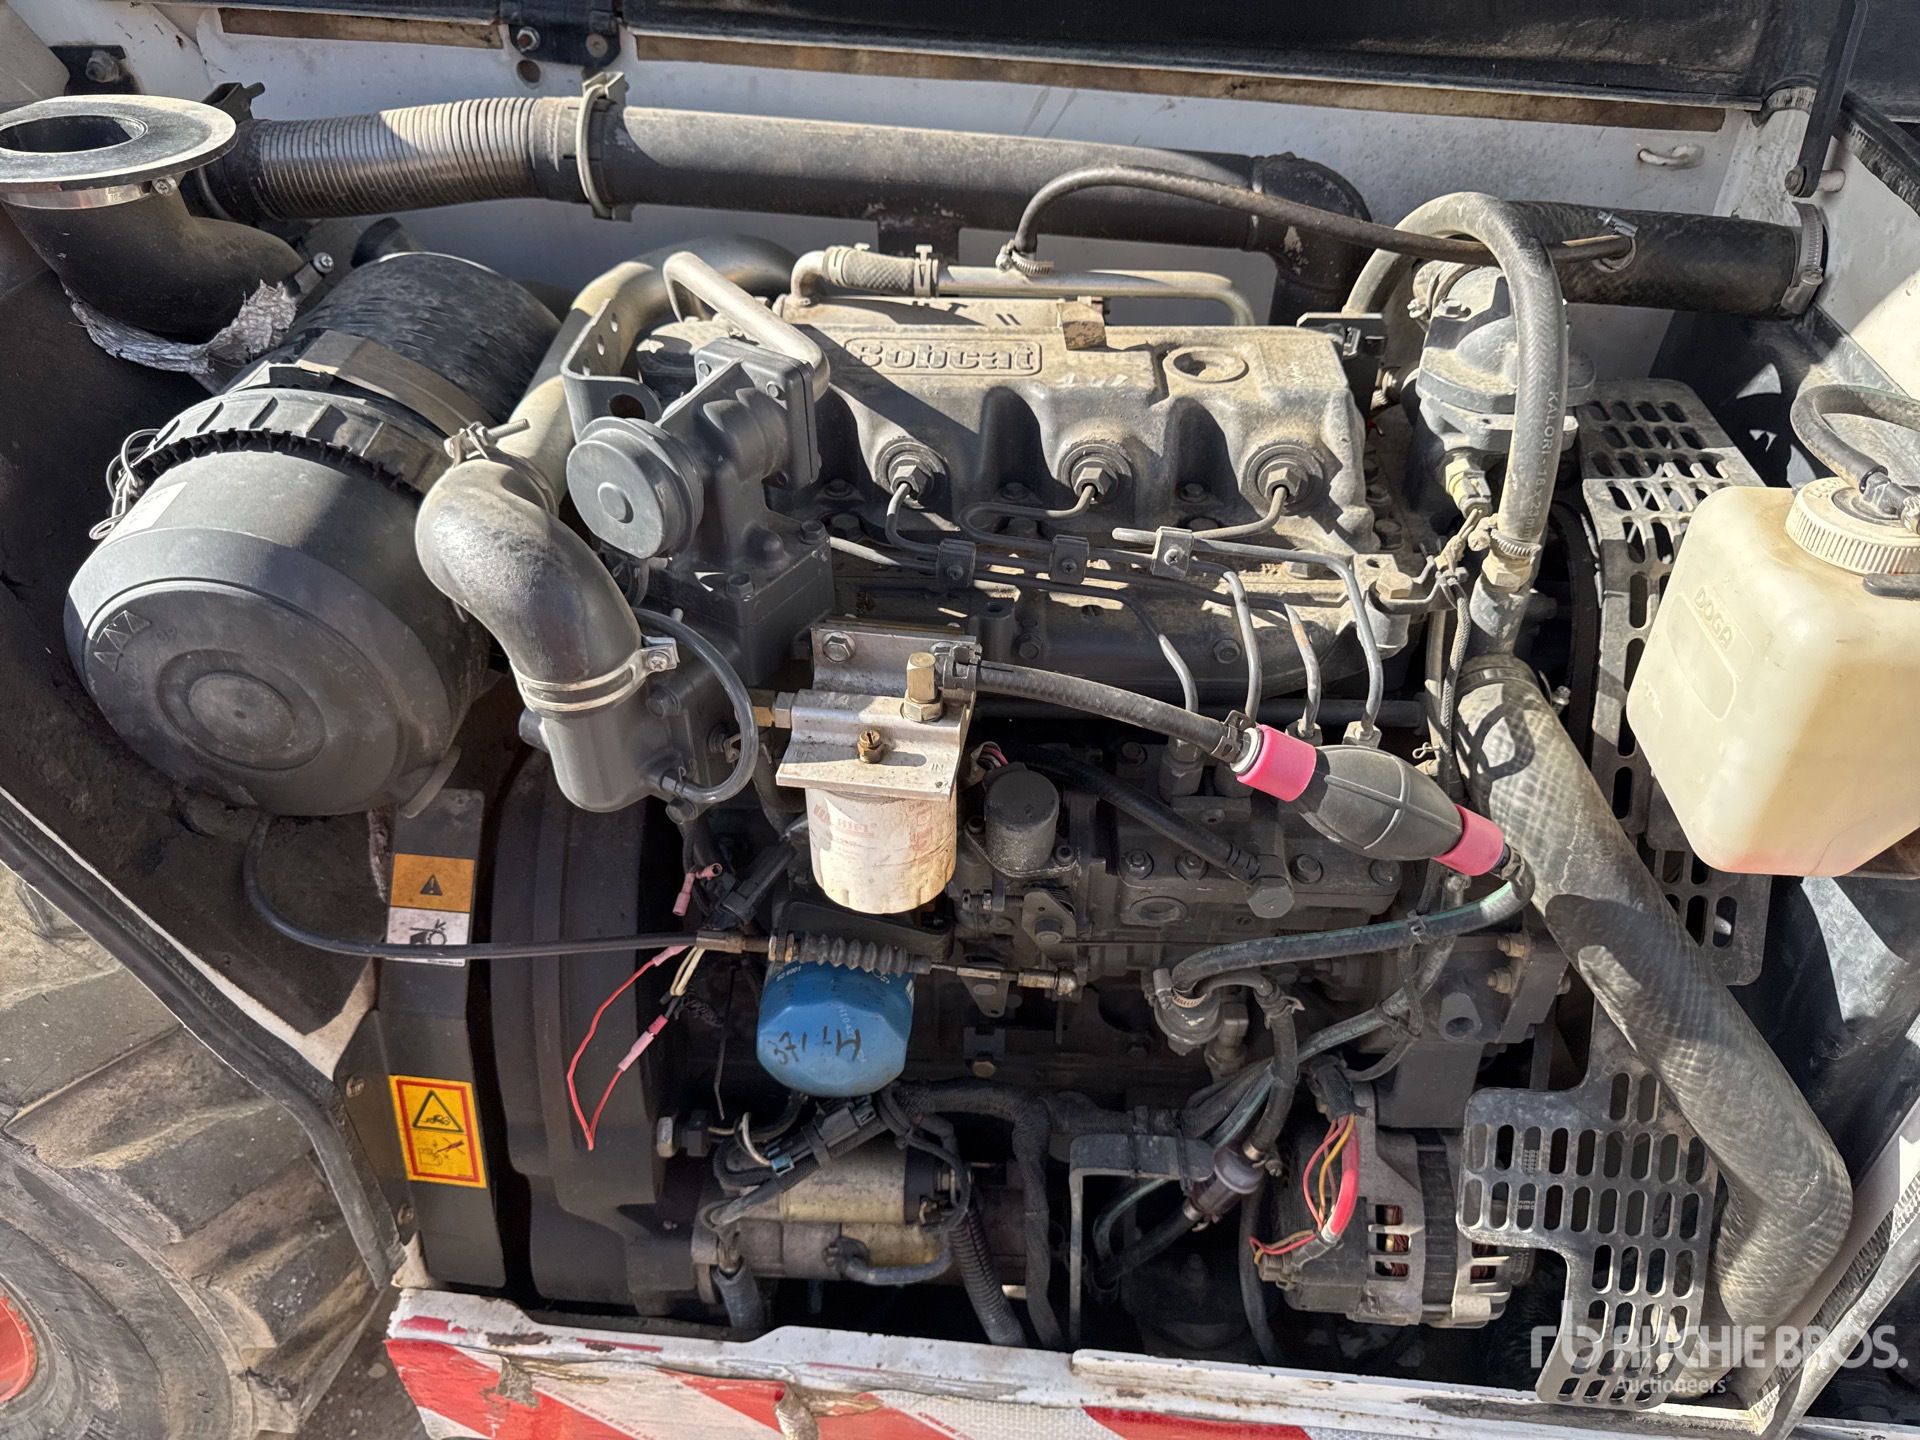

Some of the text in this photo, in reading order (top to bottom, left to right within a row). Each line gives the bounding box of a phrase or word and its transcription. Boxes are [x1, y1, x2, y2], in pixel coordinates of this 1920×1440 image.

[856, 343, 1034, 369] Bobcat
[1541, 391, 1559, 454] KALORI
[1693, 586, 1734, 651] DOGA
[931, 763, 944, 772] IN
